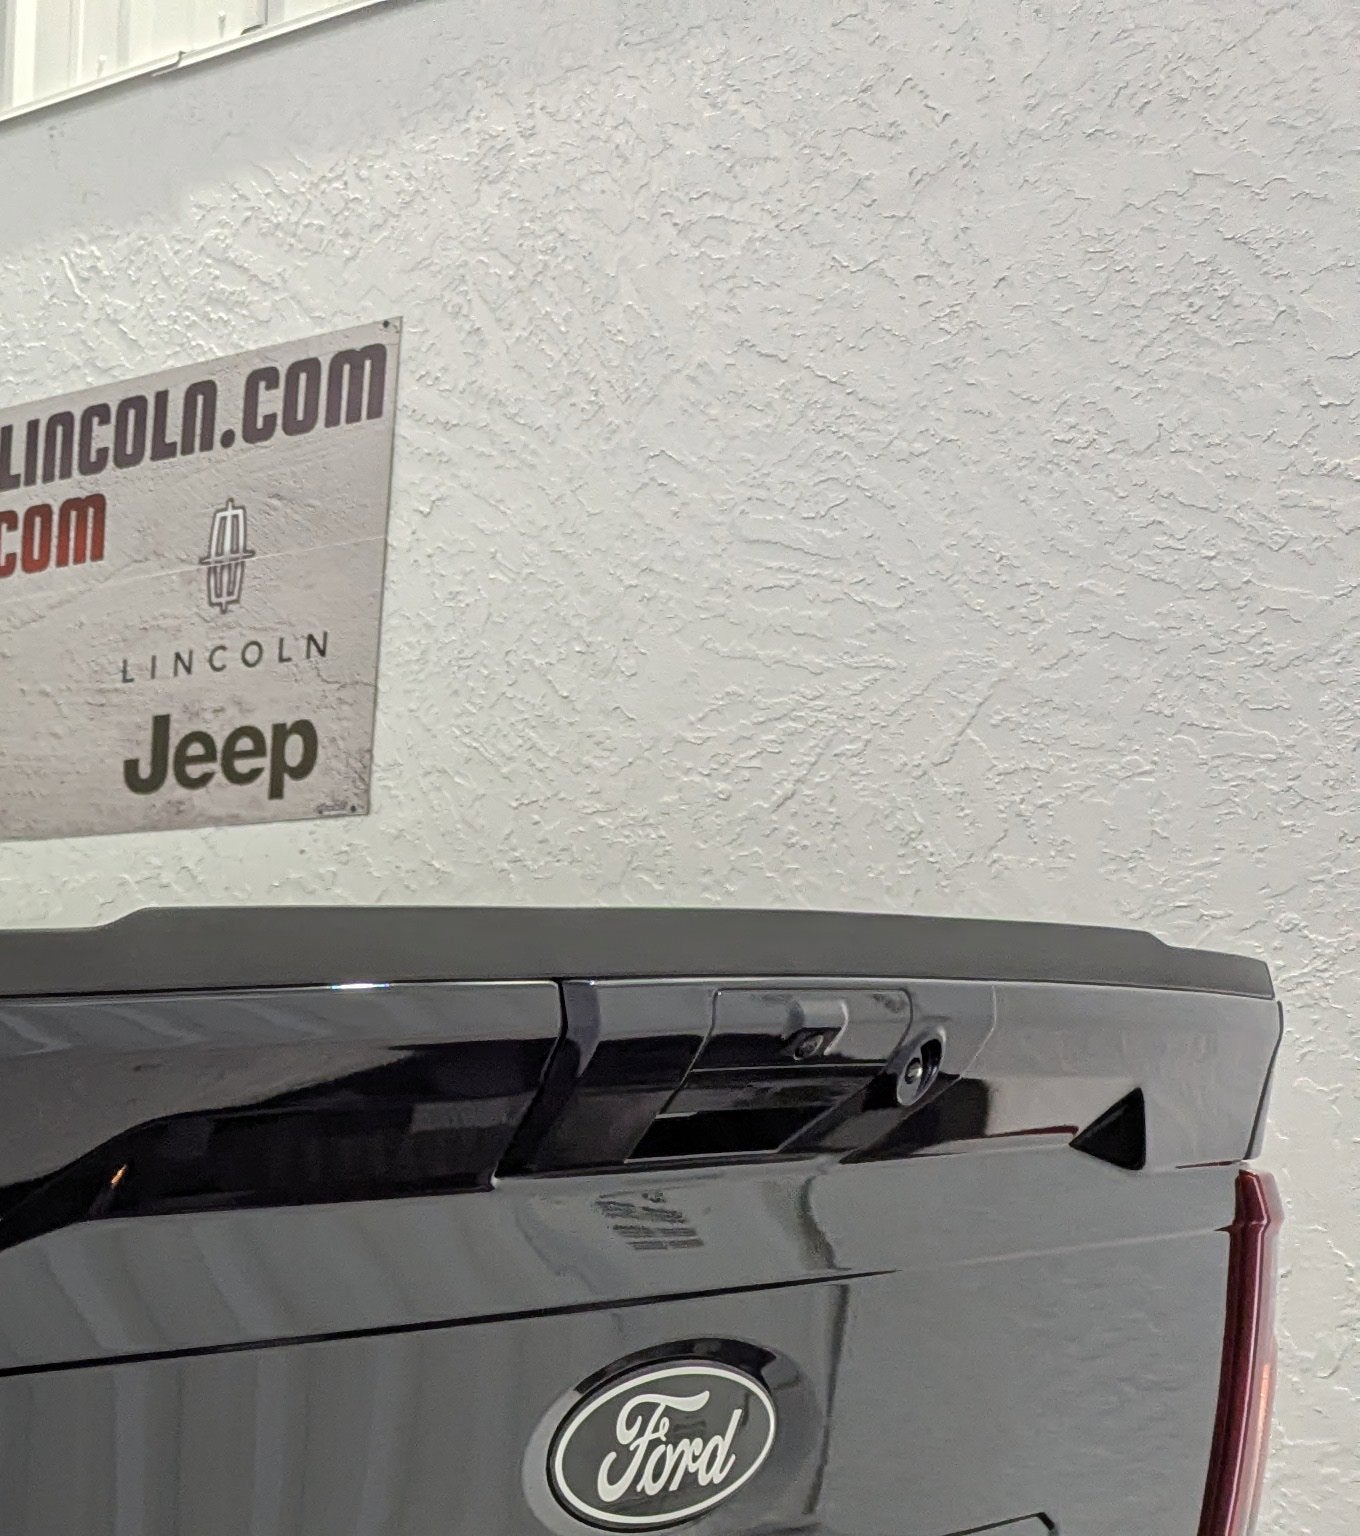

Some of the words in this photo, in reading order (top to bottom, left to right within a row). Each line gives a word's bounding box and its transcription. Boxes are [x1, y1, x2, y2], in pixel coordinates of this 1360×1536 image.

[121, 631, 328, 683] LINCOLN
[123, 713, 319, 800] Jeep
[597, 1390, 743, 1502] Ford
